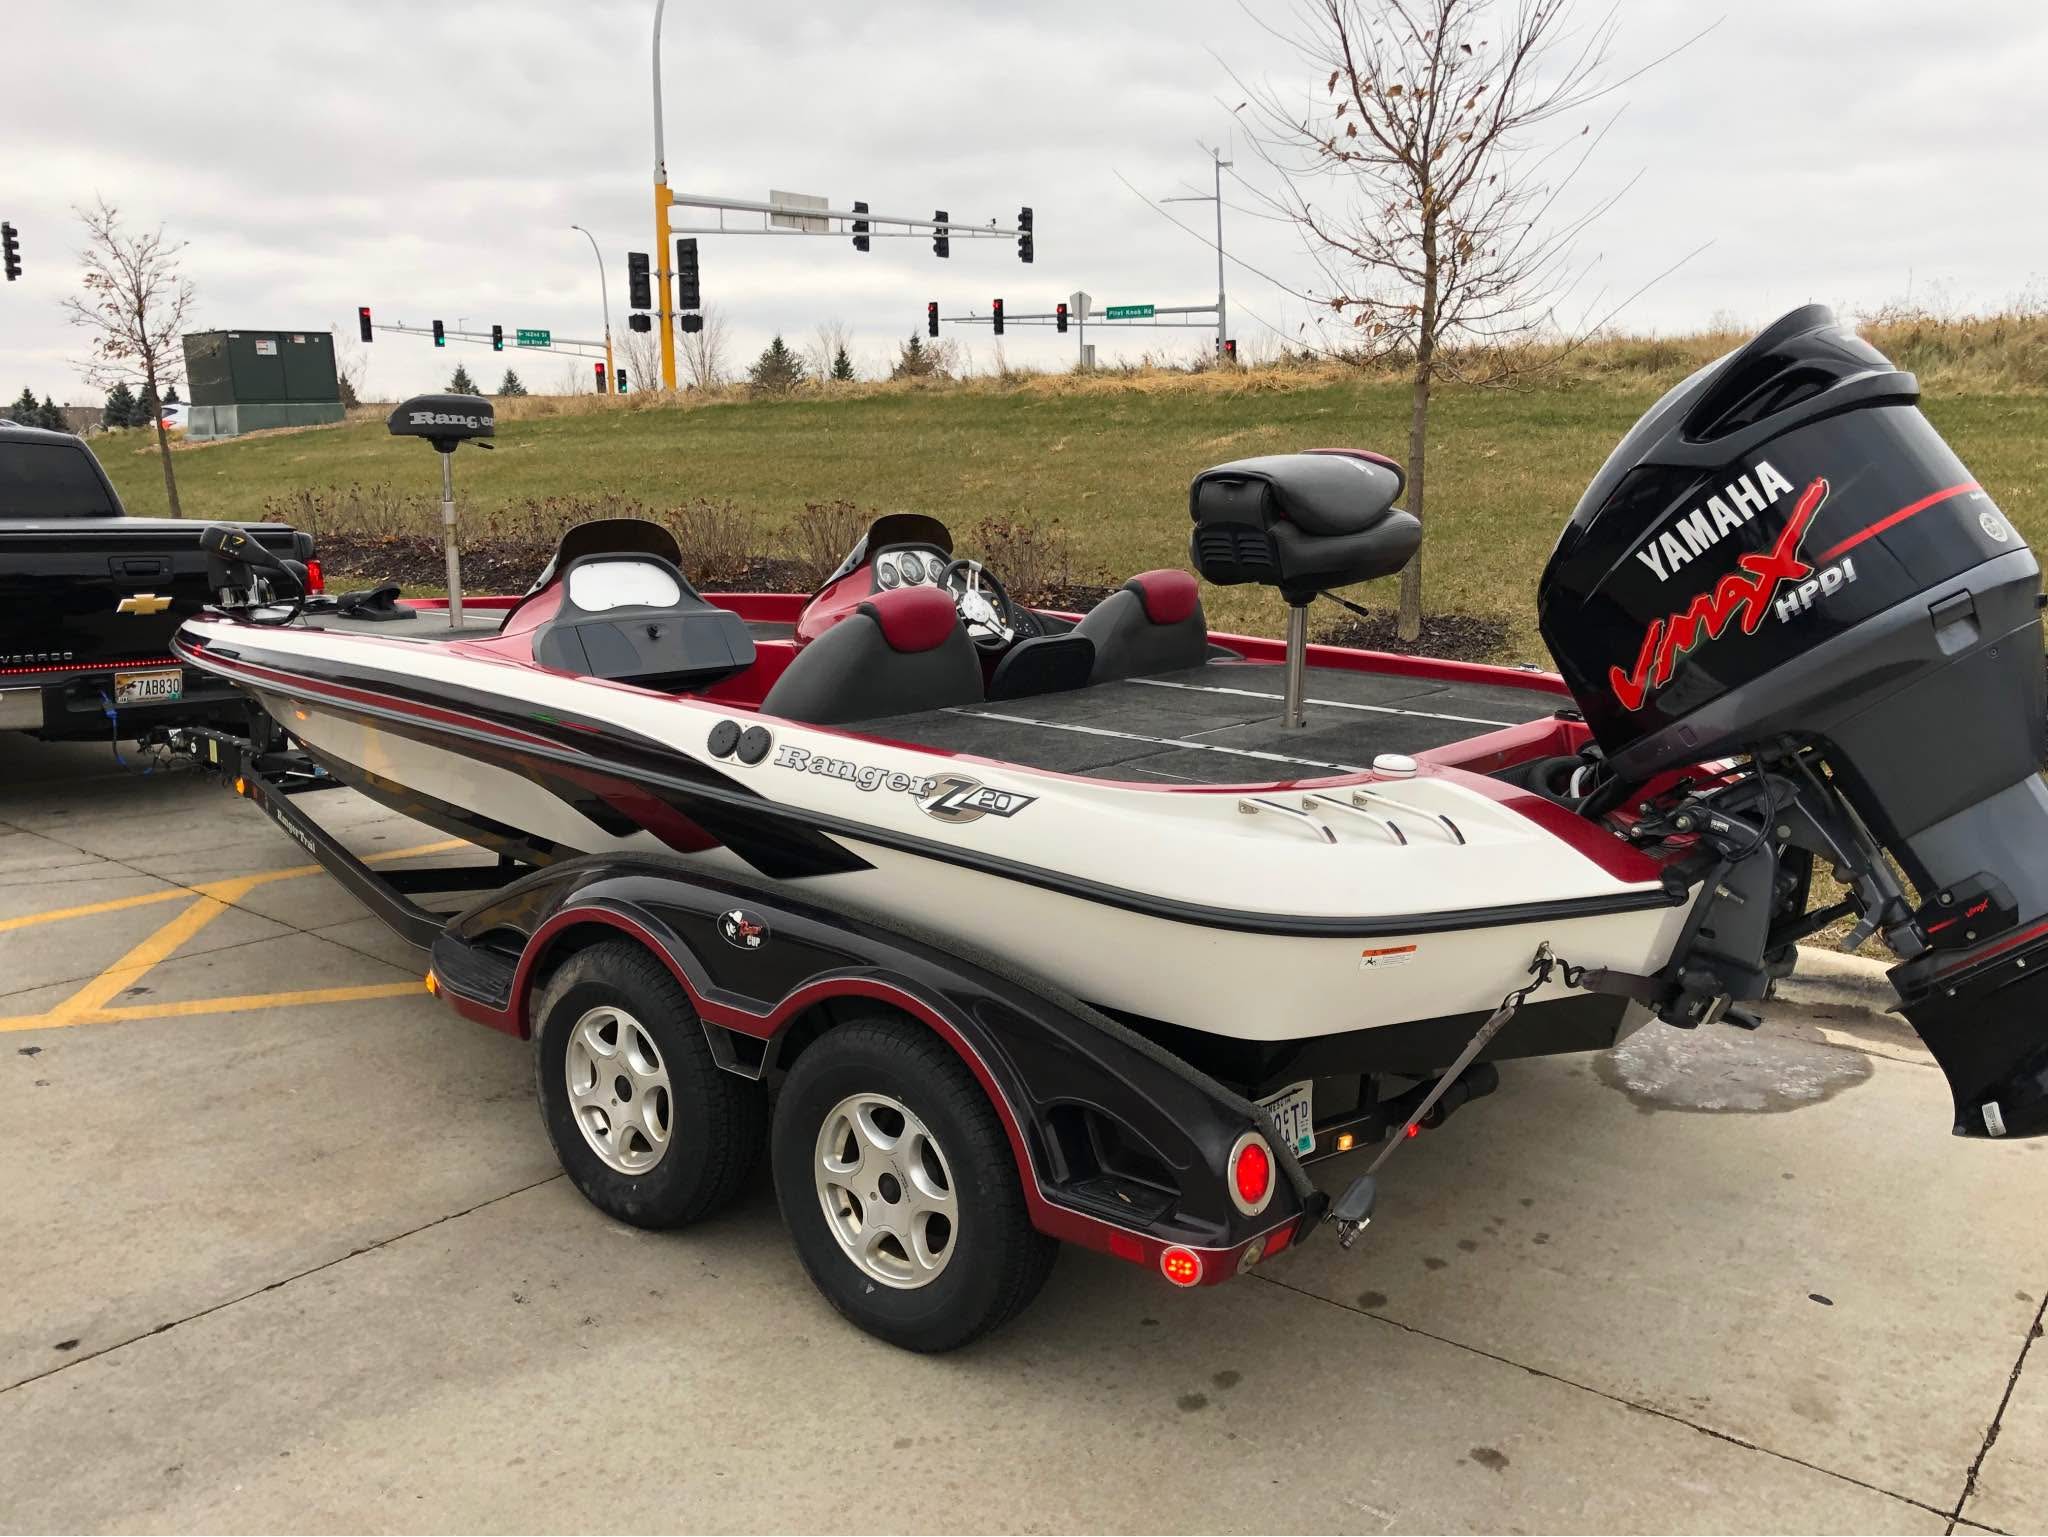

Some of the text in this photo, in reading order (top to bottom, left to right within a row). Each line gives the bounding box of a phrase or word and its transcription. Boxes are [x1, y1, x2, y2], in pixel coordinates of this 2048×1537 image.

[1636, 460, 1795, 583] YAMAHA
[1774, 557, 1857, 624] HPDI
[137, 678, 180, 696] 7AB830
[774, 744, 938, 798] Ranger
[746, 935, 761, 948] CUP
